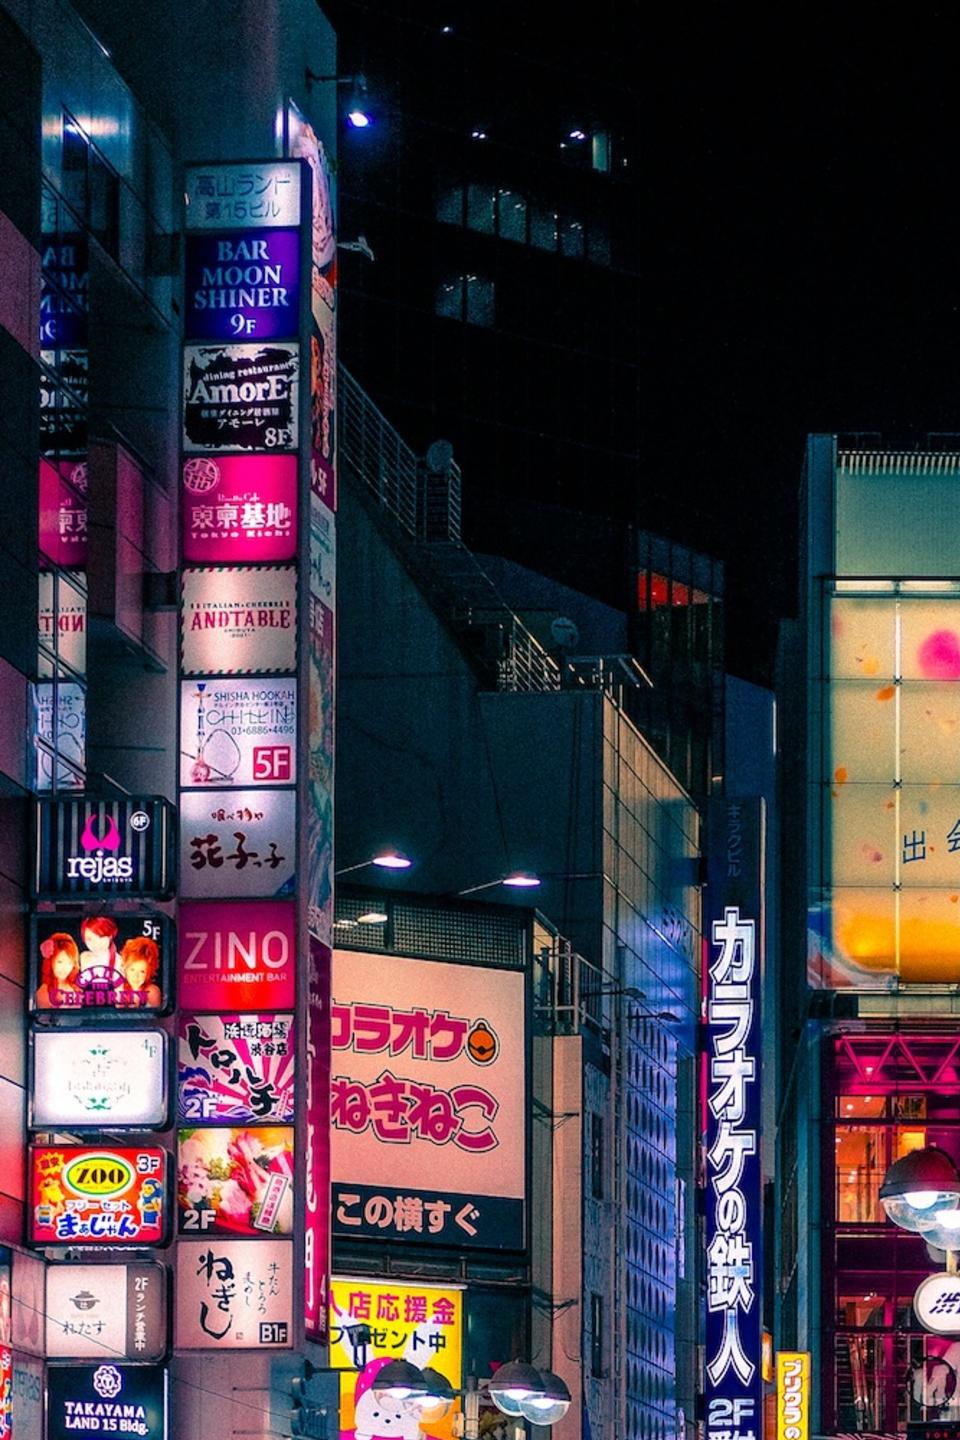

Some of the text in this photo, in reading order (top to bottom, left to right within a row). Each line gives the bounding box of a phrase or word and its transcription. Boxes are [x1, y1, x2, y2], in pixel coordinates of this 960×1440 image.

[217, 240, 269, 261] BAR
[202, 265, 281, 285] MOON
[194, 288, 289, 310] SHINER
[230, 313, 256, 334] 9F
[264, 427, 292, 447] 8F
[191, 503, 292, 529] 東京基地
[191, 609, 291, 631] ANDTABLE
[214, 690, 295, 701] SHISHA HOOKAH
[255, 749, 290, 779] 5F
[67, 850, 133, 884] rejas
[142, 919, 161, 940] 5F
[184, 930, 289, 970] ZINO
[184, 972, 287, 984] ENTERTAINMENT BAR
[185, 1098, 218, 1118] 2F
[707, 905, 757, 1388] カラオケの鉄人
[138, 1156, 159, 1172] 3F
[77, 1168, 125, 1184] ZOO
[183, 1210, 217, 1230] 2F
[336, 1192, 481, 1237] この横すぐ
[134, 1277, 149, 1291] 2F
[268, 1261, 280, 1297] 牛たん
[197, 1249, 237, 1340] ねぎし
[261, 1323, 287, 1342] B1F
[330, 1325, 447, 1353] プゼント中
[64, 1402, 145, 1418] TAKAYAMA
[708, 1398, 755, 1427] 2F
[65, 1416, 149, 1436] LAND 15 Bldg.
